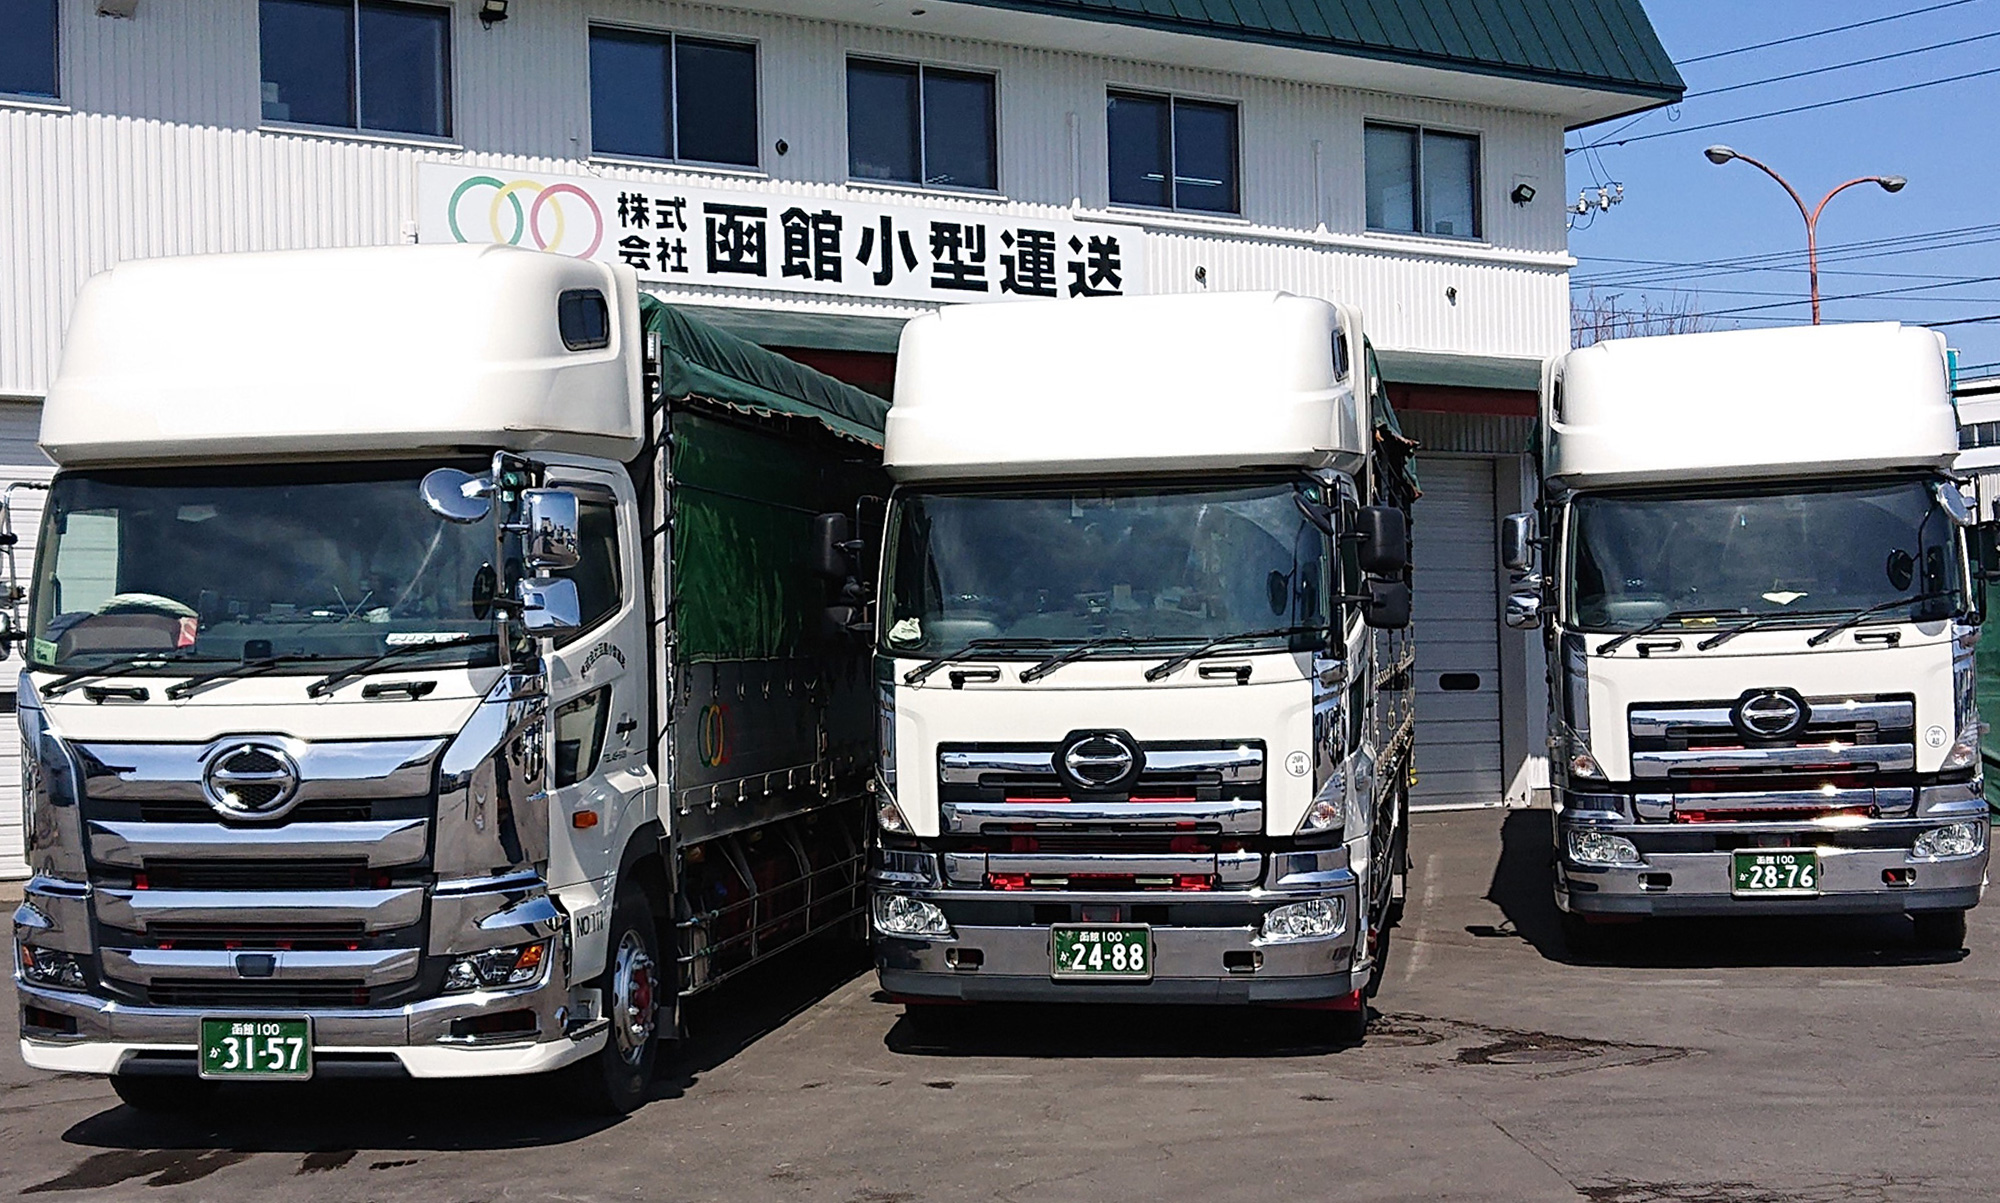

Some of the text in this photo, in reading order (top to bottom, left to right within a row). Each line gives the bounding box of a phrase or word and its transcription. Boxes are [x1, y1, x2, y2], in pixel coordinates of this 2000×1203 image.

[617, 192, 688, 232] 株式
[617, 235, 689, 273] 会社
[703, 202, 1124, 298] 函館小型運送
[1776, 855, 1795, 864] 100
[1749, 864, 1814, 888] 28-76
[1079, 931, 1123, 942] 函館 100
[1059, 943, 1145, 970] か 24-88
[231, 1023, 280, 1036] 函館 100
[209, 1037, 303, 1070] か 31-57
